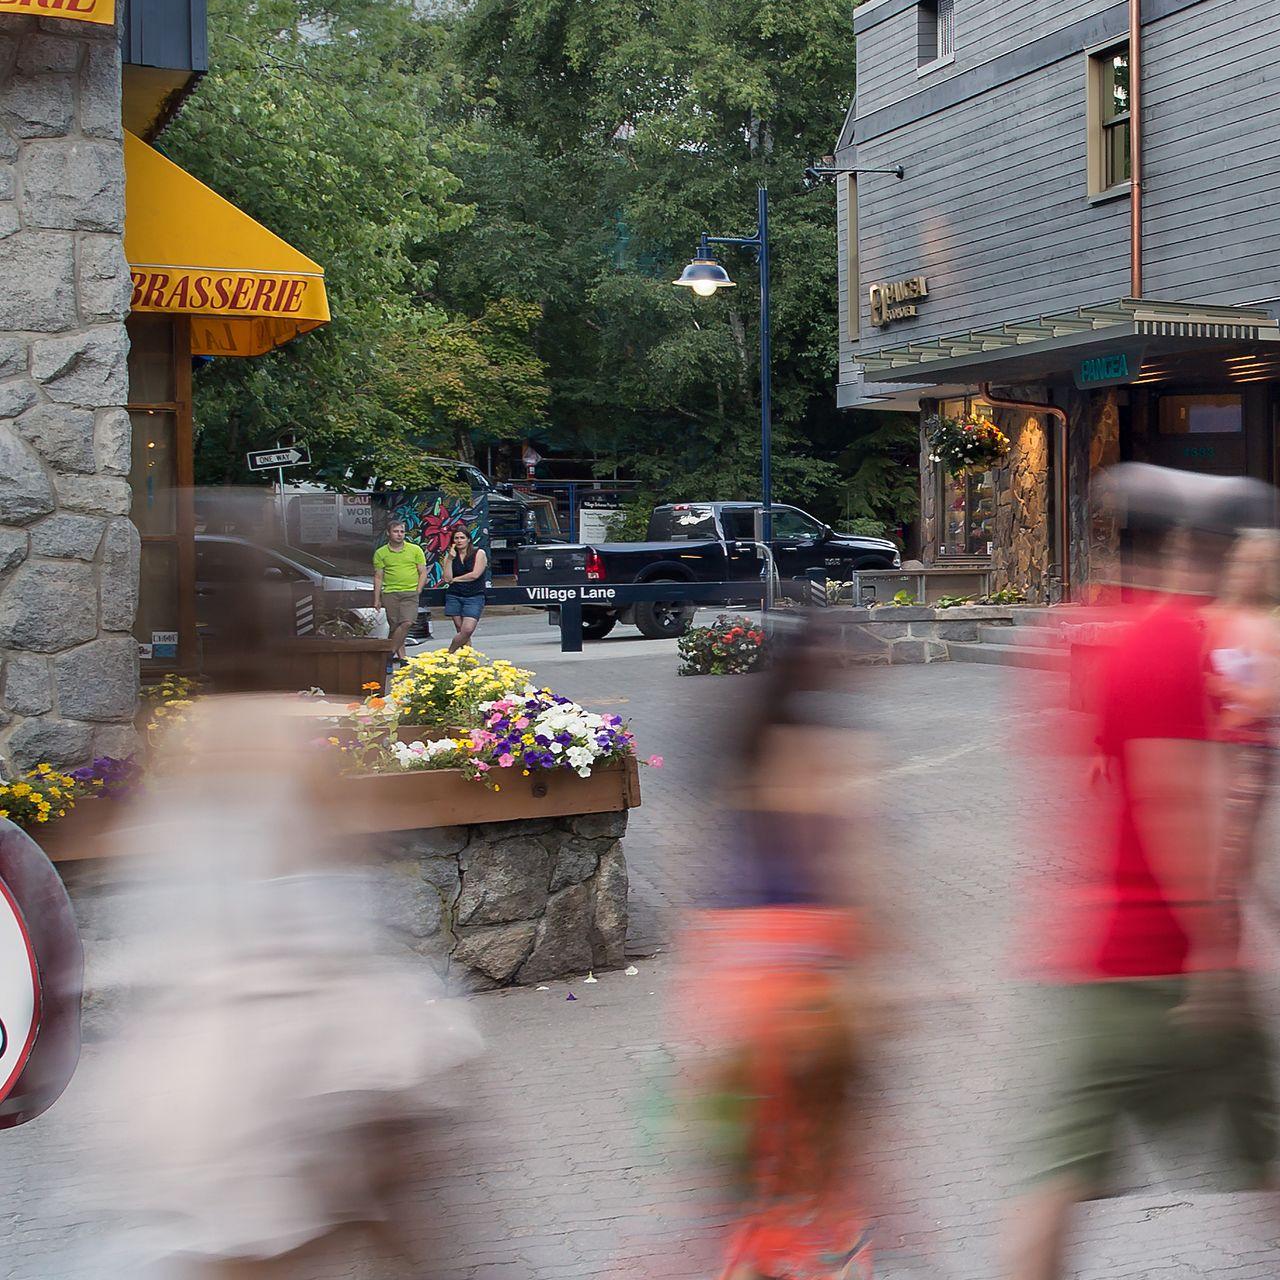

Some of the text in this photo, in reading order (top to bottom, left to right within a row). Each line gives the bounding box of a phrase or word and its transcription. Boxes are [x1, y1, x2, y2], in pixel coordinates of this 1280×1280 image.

[1081, 354, 1128, 383] PANGEA
[259, 453, 290, 464] ONE WAY
[347, 496, 371, 505] CAU
[526, 586, 616, 601] Village Lane
